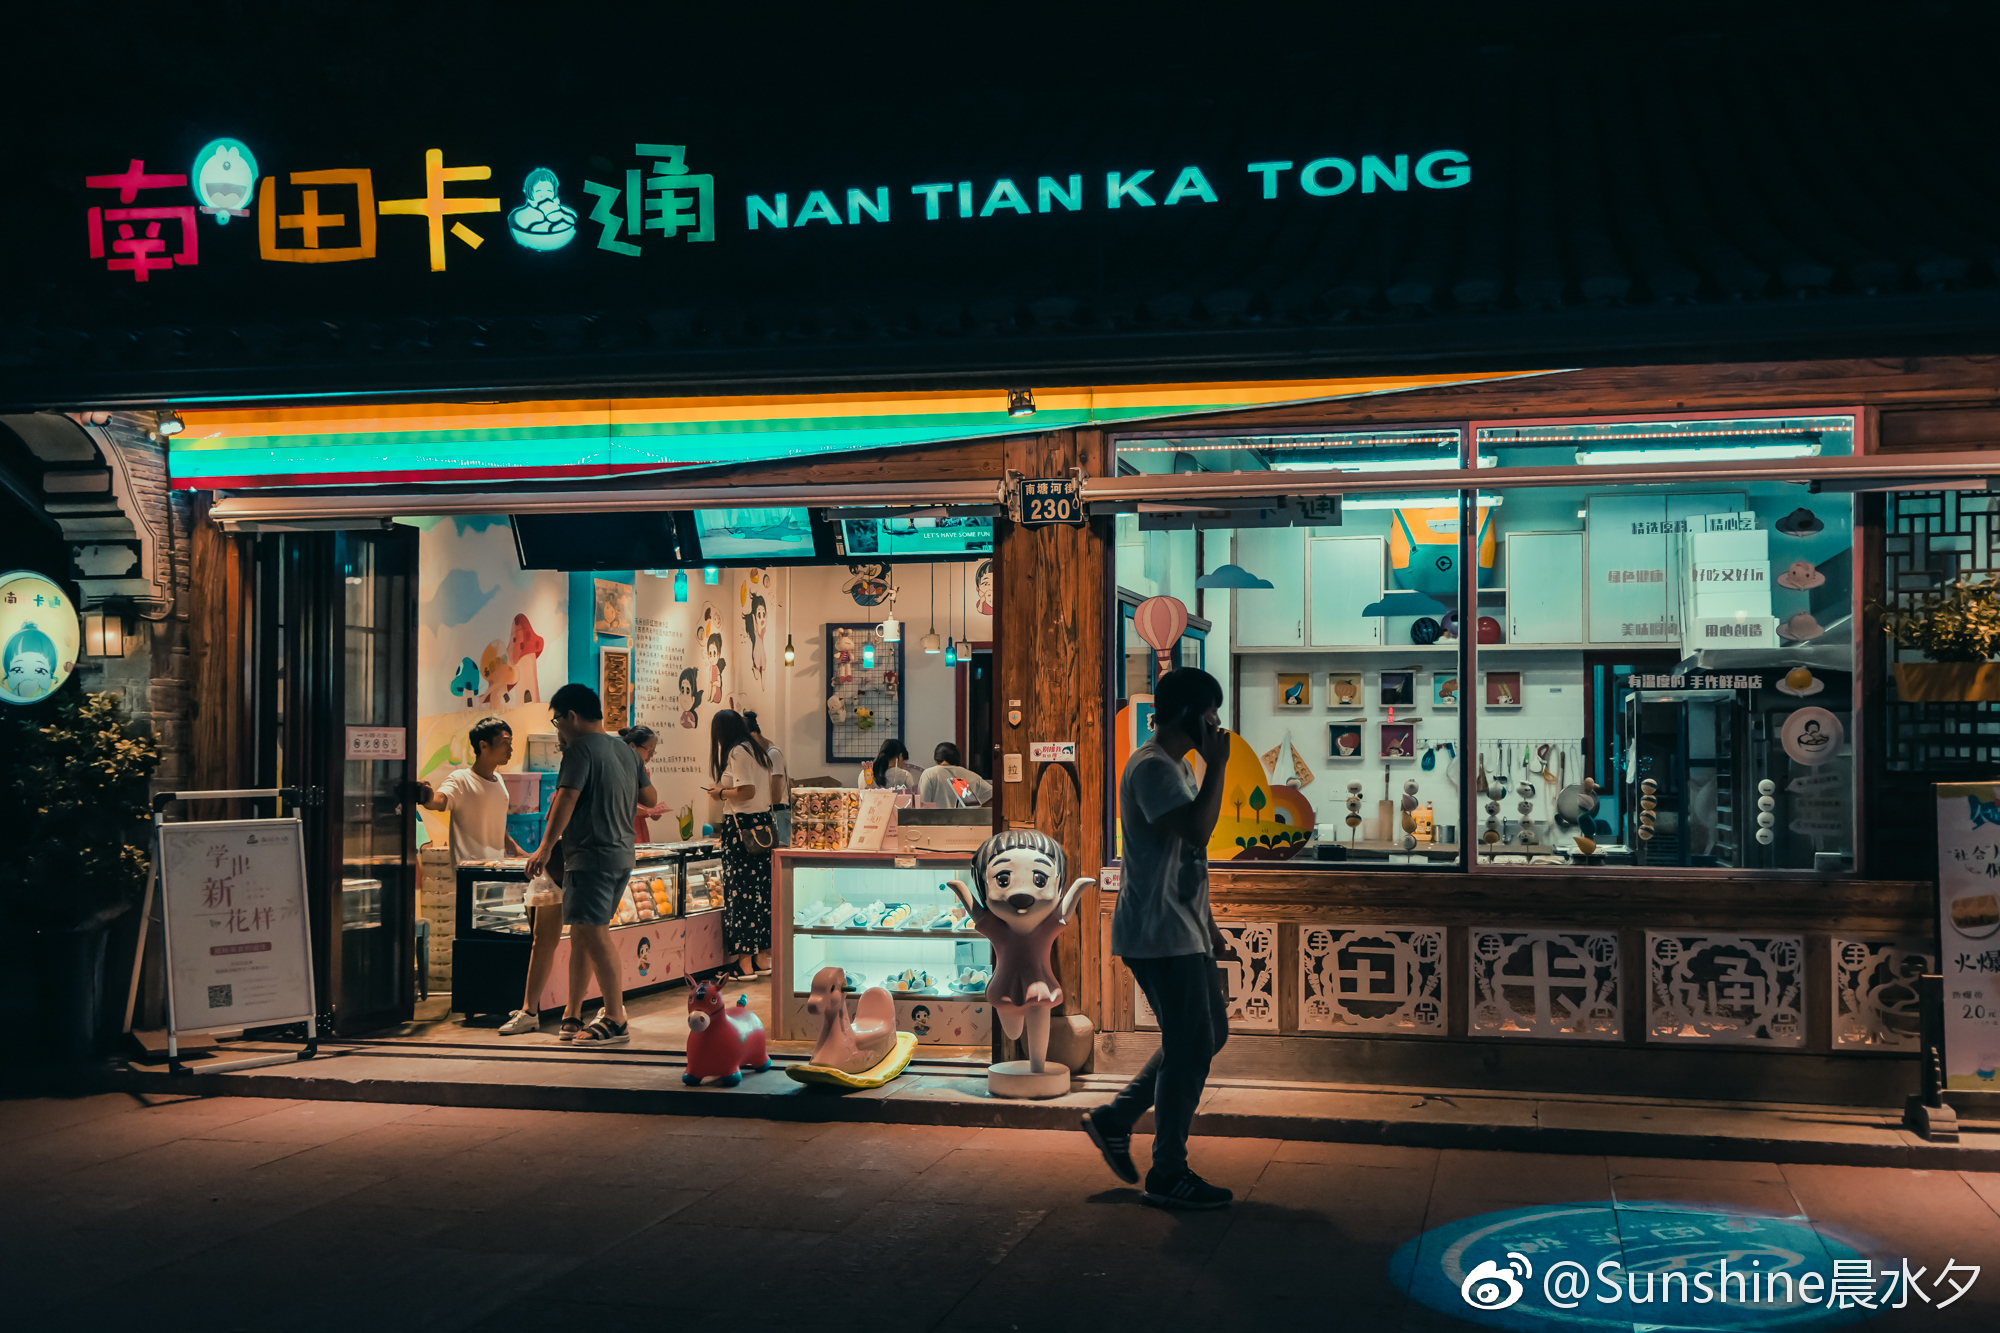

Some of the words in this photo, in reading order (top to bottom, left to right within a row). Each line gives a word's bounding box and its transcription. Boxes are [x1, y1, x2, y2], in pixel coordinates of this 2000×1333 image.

[746, 185, 890, 230] NAN
[911, 174, 1083, 221] TIAN
[1107, 166, 1219, 210] KA
[1247, 149, 1472, 200] TONG
[1030, 499, 1071, 520] 230
[1692, 567, 1764, 582] 好吃又好玩
[1705, 623, 1763, 638] 用心创造
[1628, 674, 1685, 689] 有温度的
[1690, 674, 1763, 689] 手作鲜品店
[1008, 764, 1019, 775] 拉
[202, 876, 235, 909] 新
